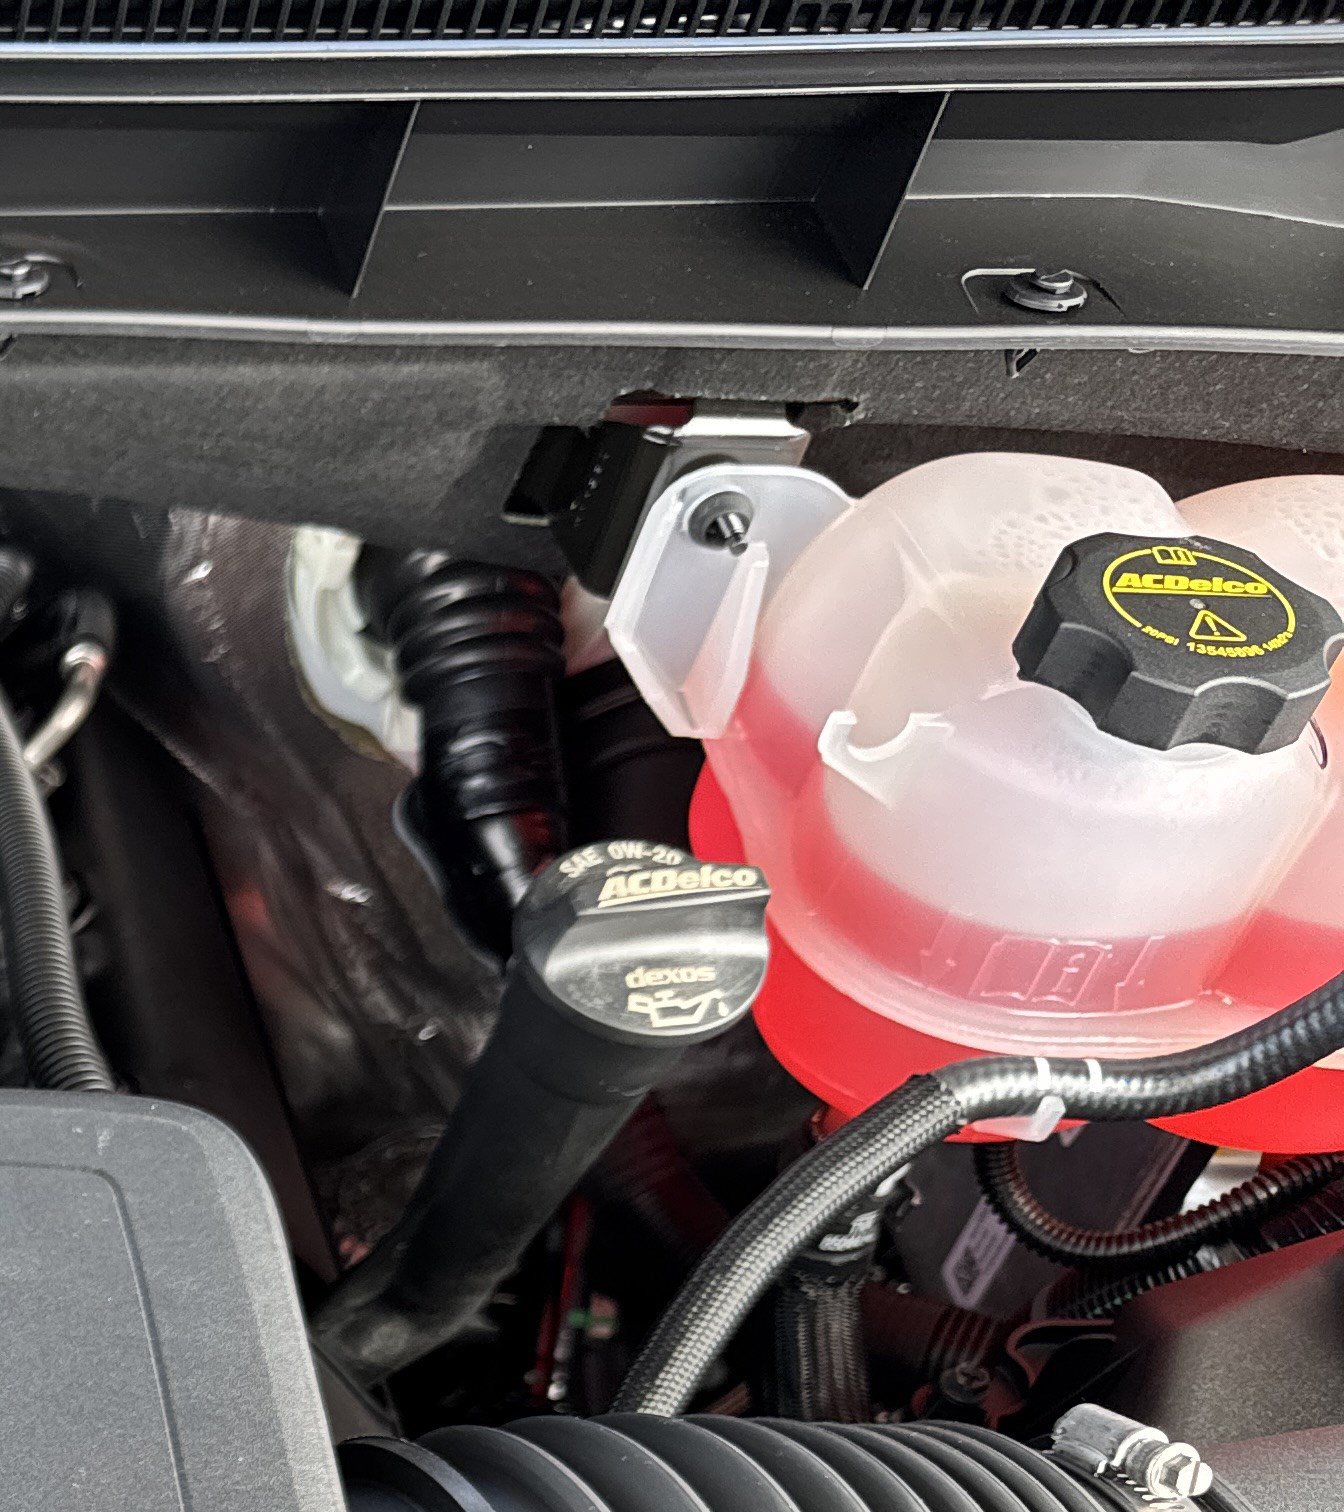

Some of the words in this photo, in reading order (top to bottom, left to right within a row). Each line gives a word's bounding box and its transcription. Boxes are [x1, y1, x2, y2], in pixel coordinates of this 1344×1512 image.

[1116, 572, 1269, 595] ACDelco
[559, 846, 604, 879] SAE
[607, 841, 683, 866] 0W-20
[597, 864, 758, 902] ACDelco
[625, 965, 717, 989] dexos
